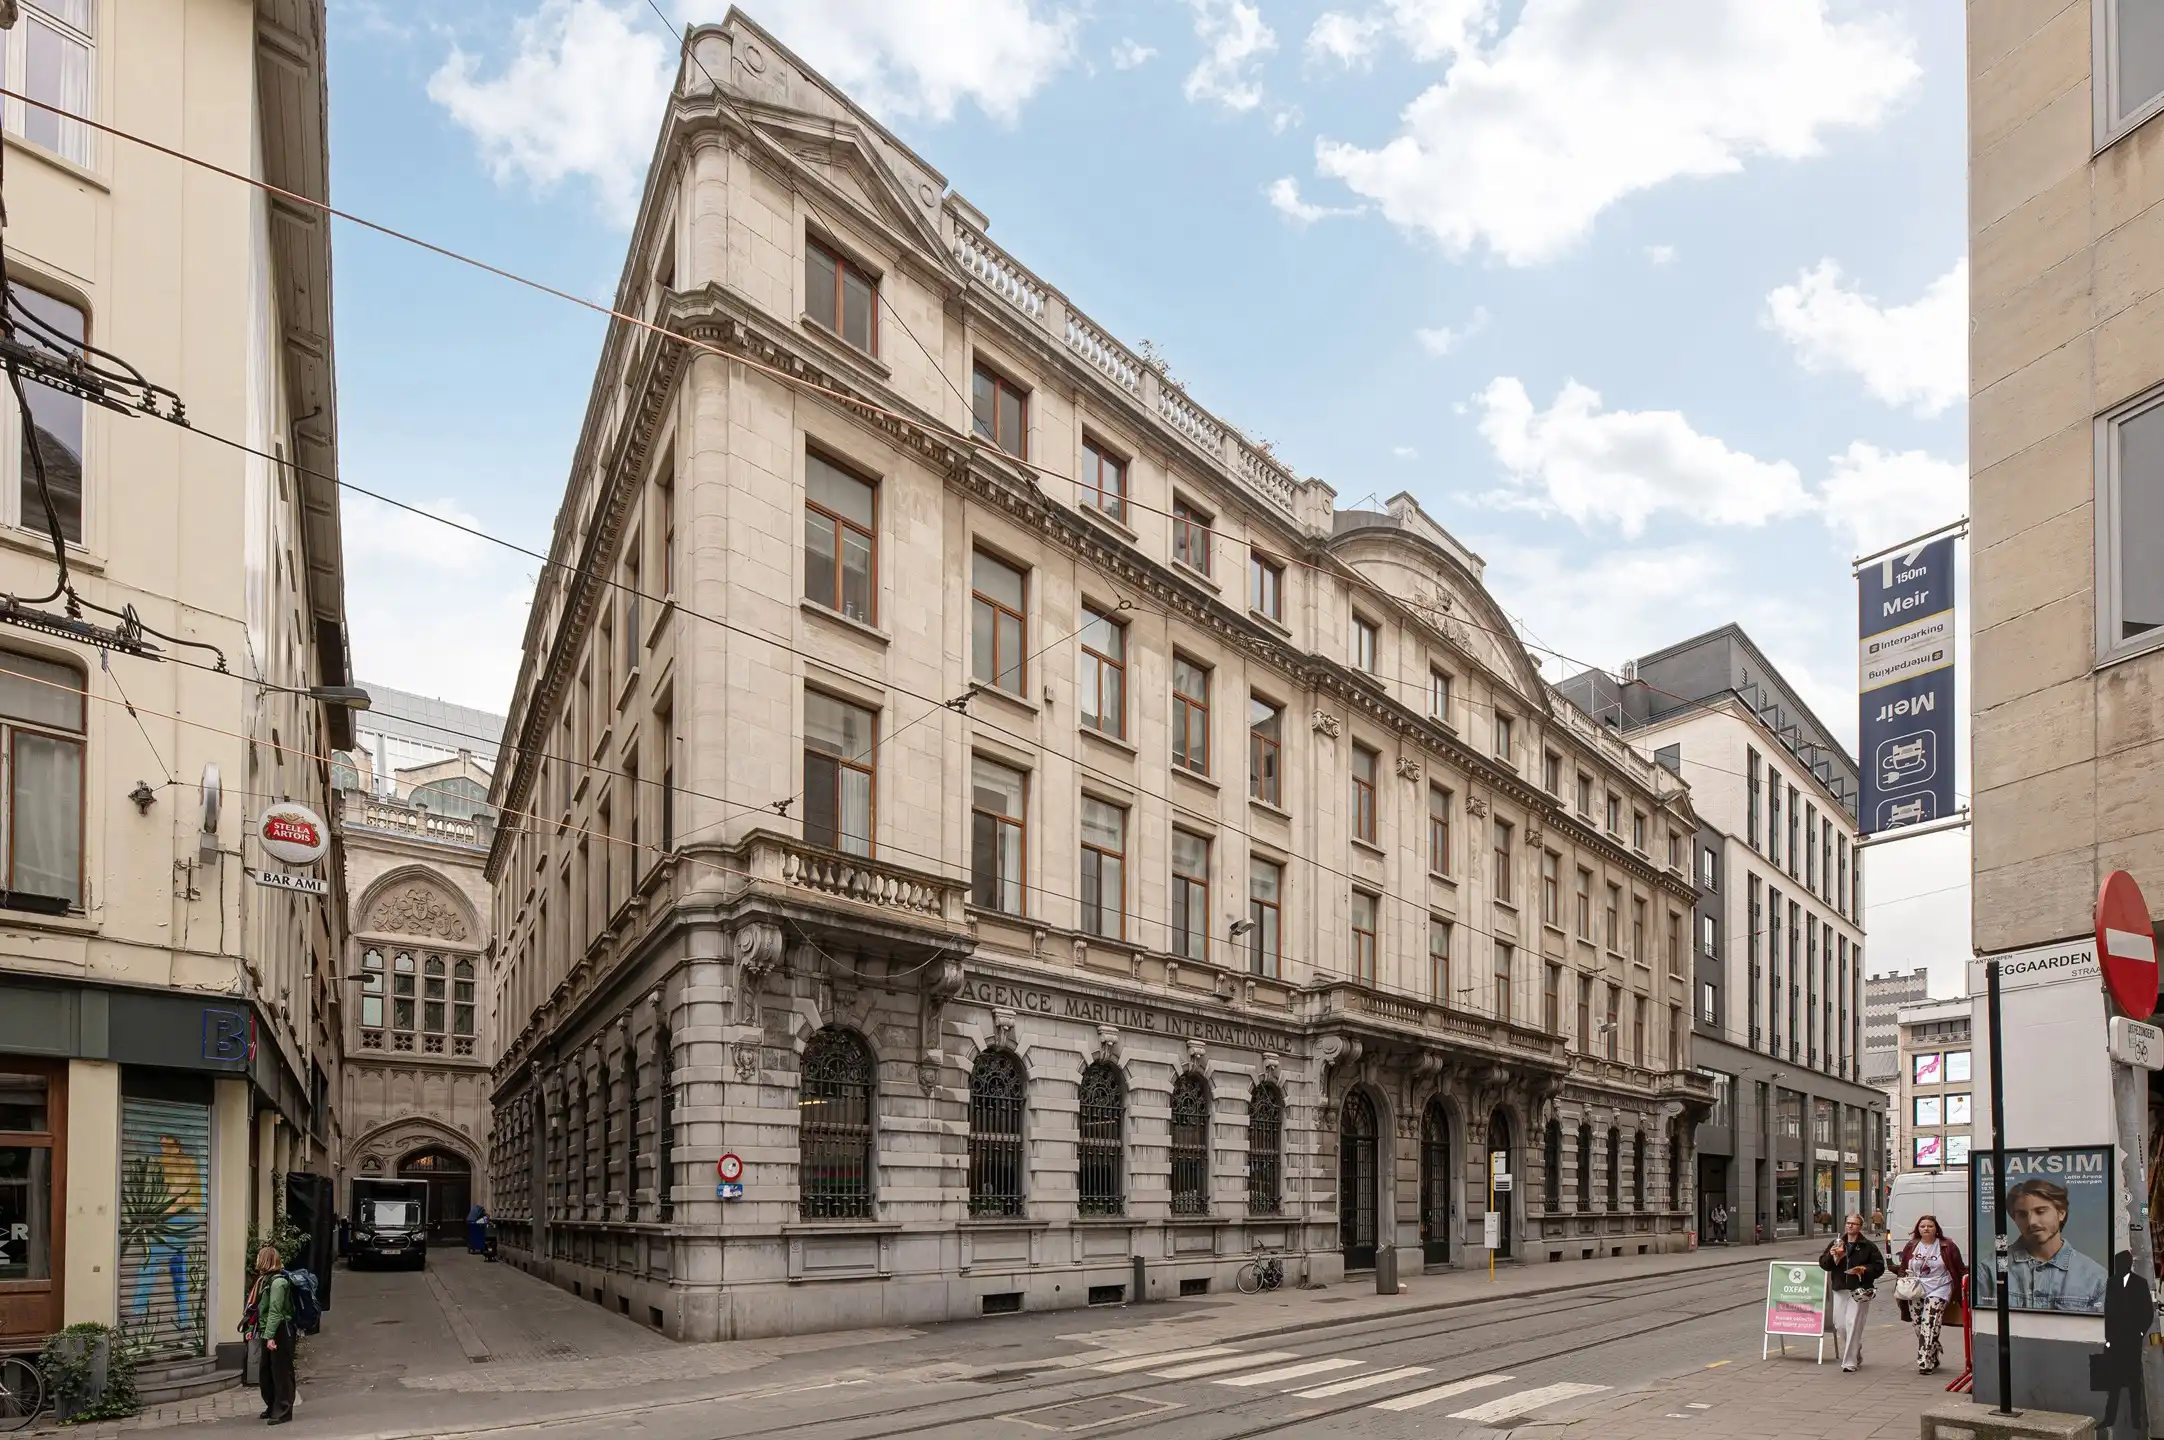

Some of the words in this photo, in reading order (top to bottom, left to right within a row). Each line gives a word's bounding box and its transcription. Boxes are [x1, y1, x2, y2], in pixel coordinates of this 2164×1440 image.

[1896, 566, 1927, 584] 150m
[1883, 590, 1929, 618] Meir
[1881, 624, 1944, 650] Interparking
[1868, 655, 1931, 680] Interparking
[1876, 692, 1934, 722] Meir
[273, 829, 311, 842] ARTOIS
[274, 822, 310, 835] STELLA
[263, 872, 291, 886] BAR
[294, 878, 321, 891] AMI
[1975, 954, 2013, 965] ANTWERPEN
[1985, 952, 2092, 979] EGGAARDEN
[2071, 966, 2101, 977] STRAA
[961, 980, 1052, 1013] AGENCE
[1065, 997, 1155, 1030] MARITIME
[1165, 1015, 1293, 1053] INTERNATIONALE
[1981, 1153, 2103, 1175] MAKSIM
[1783, 1285, 1810, 1294] OXFAM
